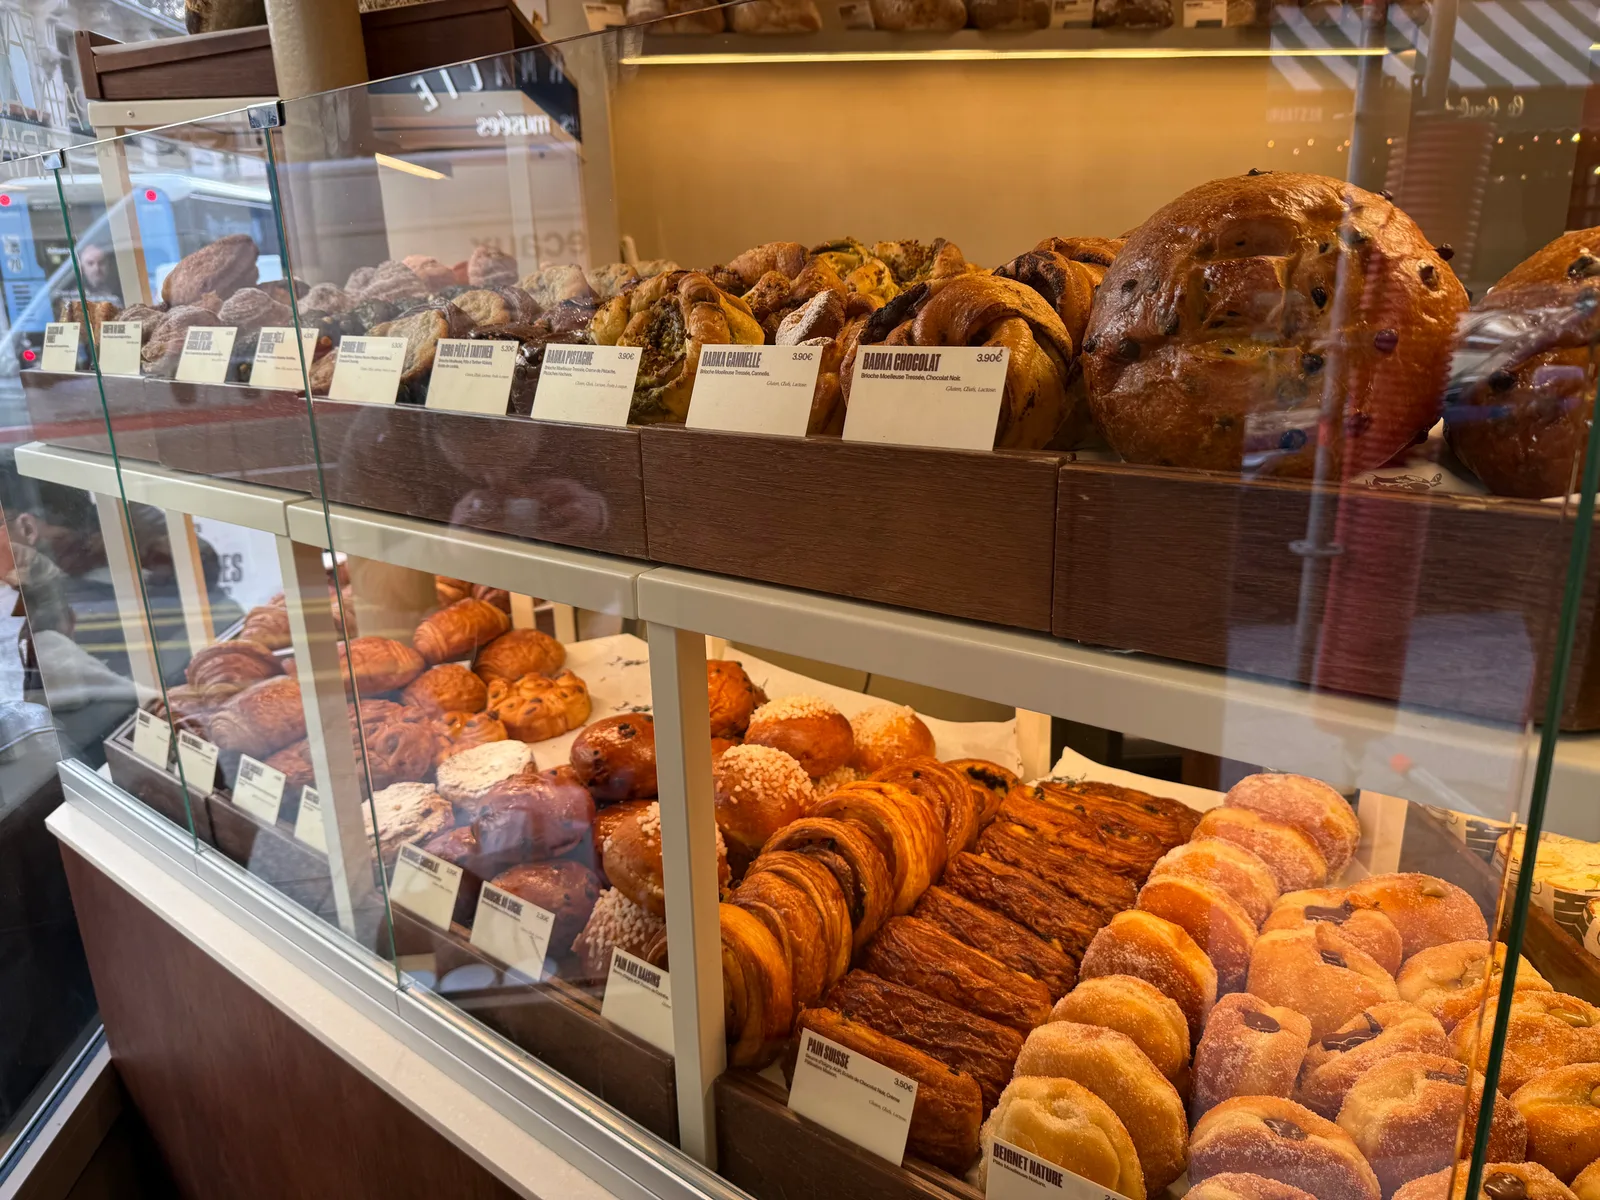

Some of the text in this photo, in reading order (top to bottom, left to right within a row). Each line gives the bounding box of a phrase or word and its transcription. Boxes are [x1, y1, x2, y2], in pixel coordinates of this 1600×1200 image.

[618, 352, 635, 360] 3.90€
[701, 351, 762, 368] BABKA CANNELLE
[792, 352, 813, 361] 3.90€
[862, 352, 941, 372] BABKA CHOCOLAT
[976, 353, 1003, 363] 3.90€
[614, 953, 661, 988] PAIN AUX RAISINS
[807, 1036, 850, 1069] PAIN SUISSE
[894, 1077, 914, 1093] 3.50€
[993, 1142, 1064, 1188] BEIGNET NATURE
